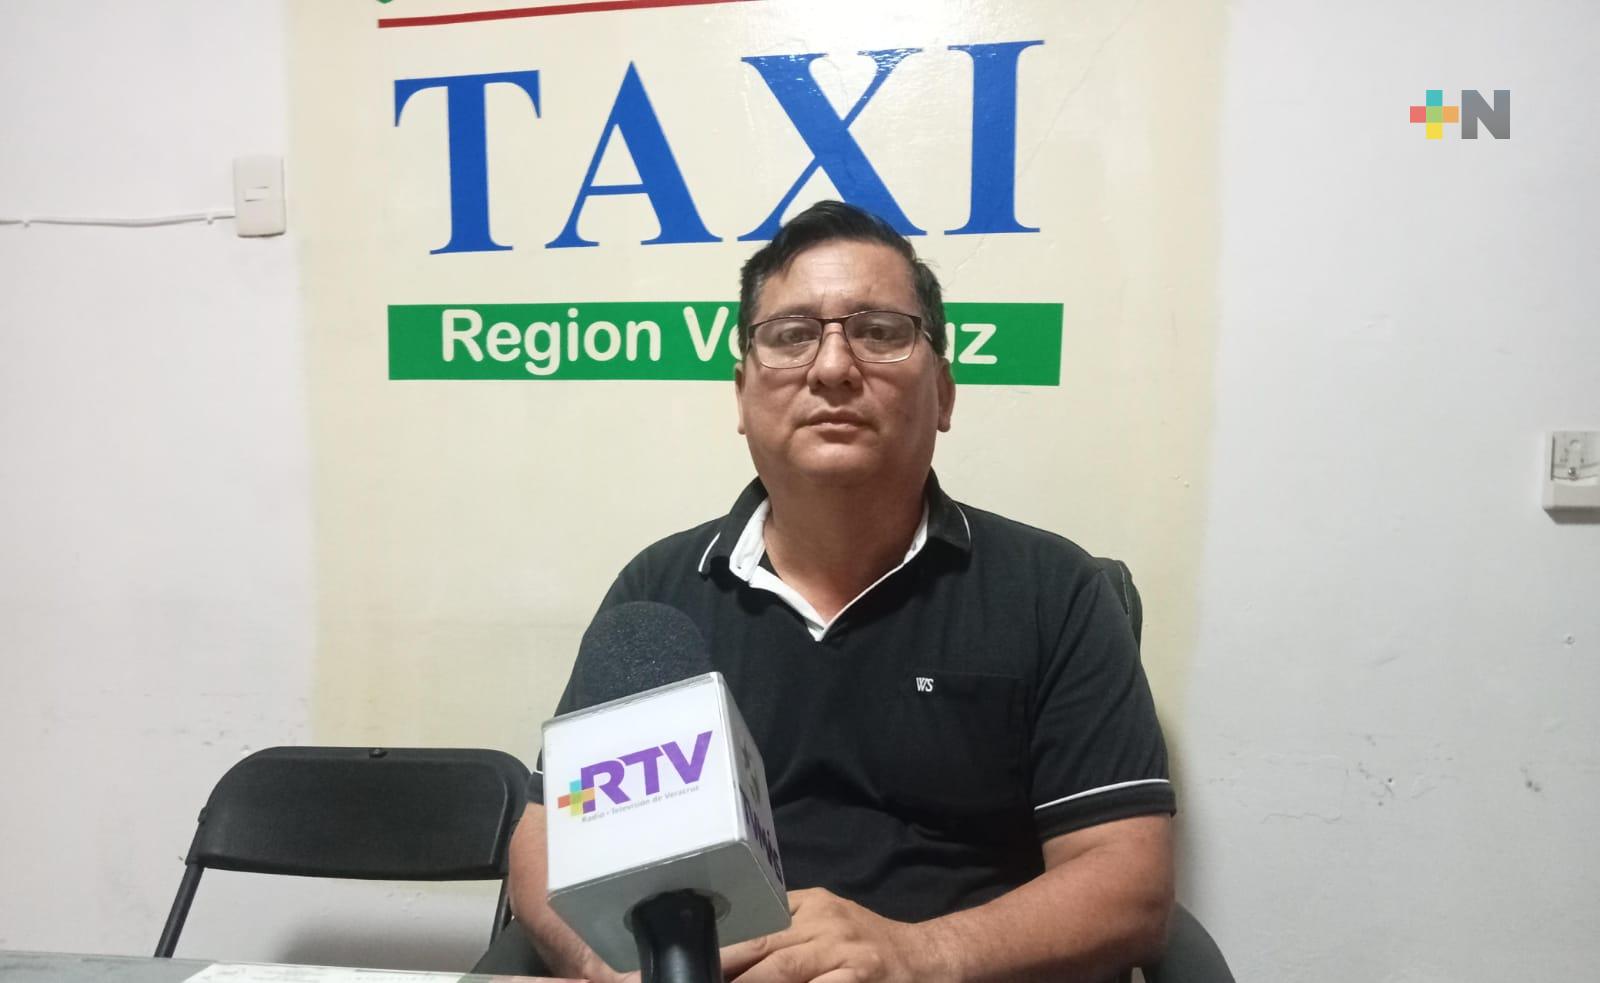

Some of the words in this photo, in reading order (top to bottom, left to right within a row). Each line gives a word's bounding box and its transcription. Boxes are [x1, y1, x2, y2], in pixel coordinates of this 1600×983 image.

[394, 40, 1044, 255] TAXI
[441, 307, 662, 376] Region
[580, 730, 713, 814] RTV
